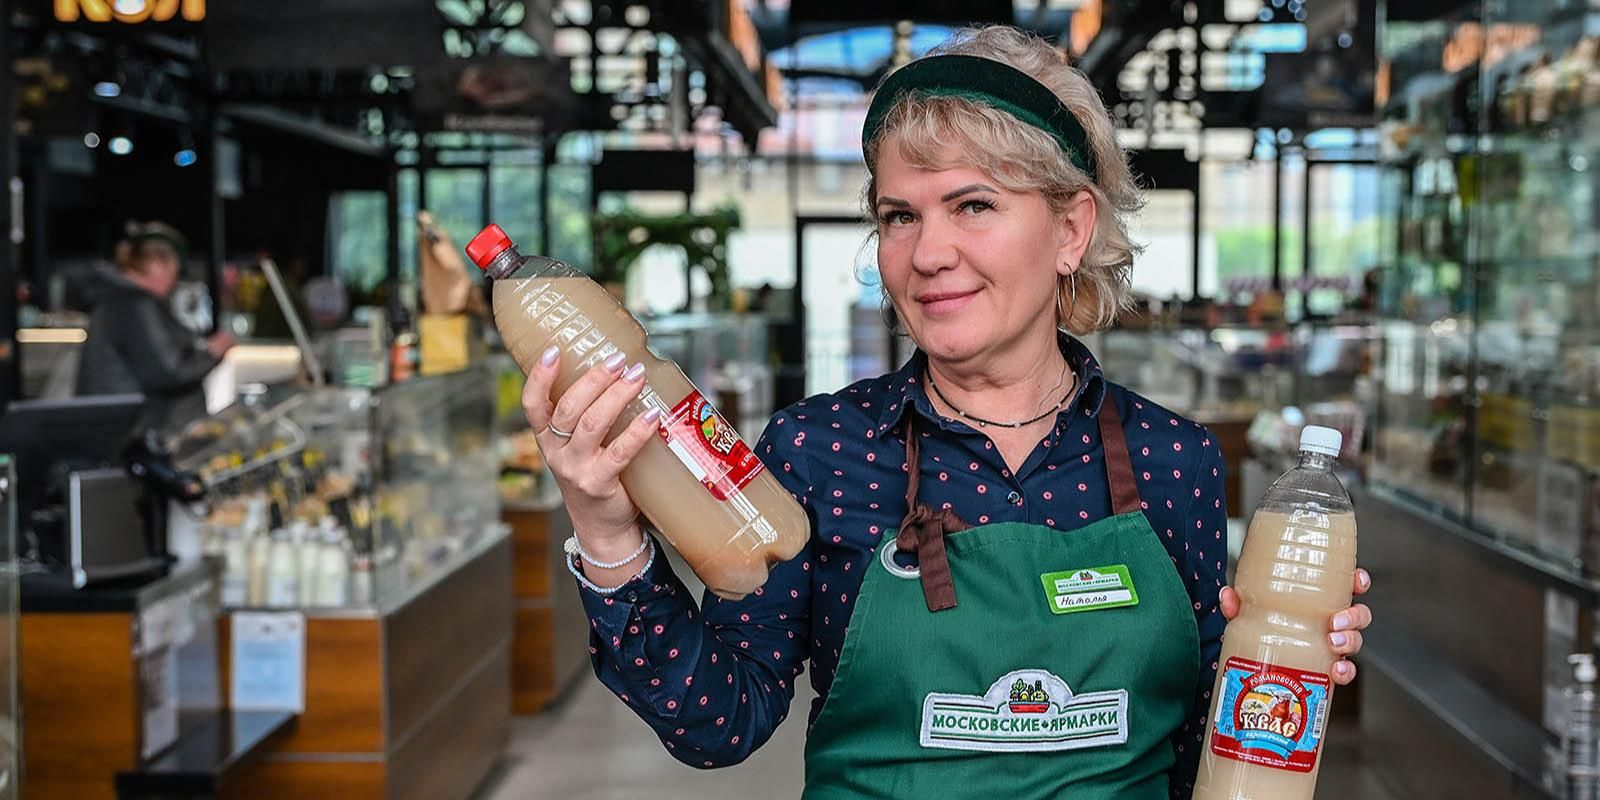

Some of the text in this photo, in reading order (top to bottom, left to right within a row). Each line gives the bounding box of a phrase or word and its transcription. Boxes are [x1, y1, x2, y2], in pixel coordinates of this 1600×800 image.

[1057, 580, 1092, 588] МОСКОВСКИЕ
[1249, 674, 1303, 695] РОМАНОВСКИЙ
[932, 711, 1118, 732] МОСКОВСКИЕ ЯРМАРКИ
[1242, 713, 1297, 738] КВАС
